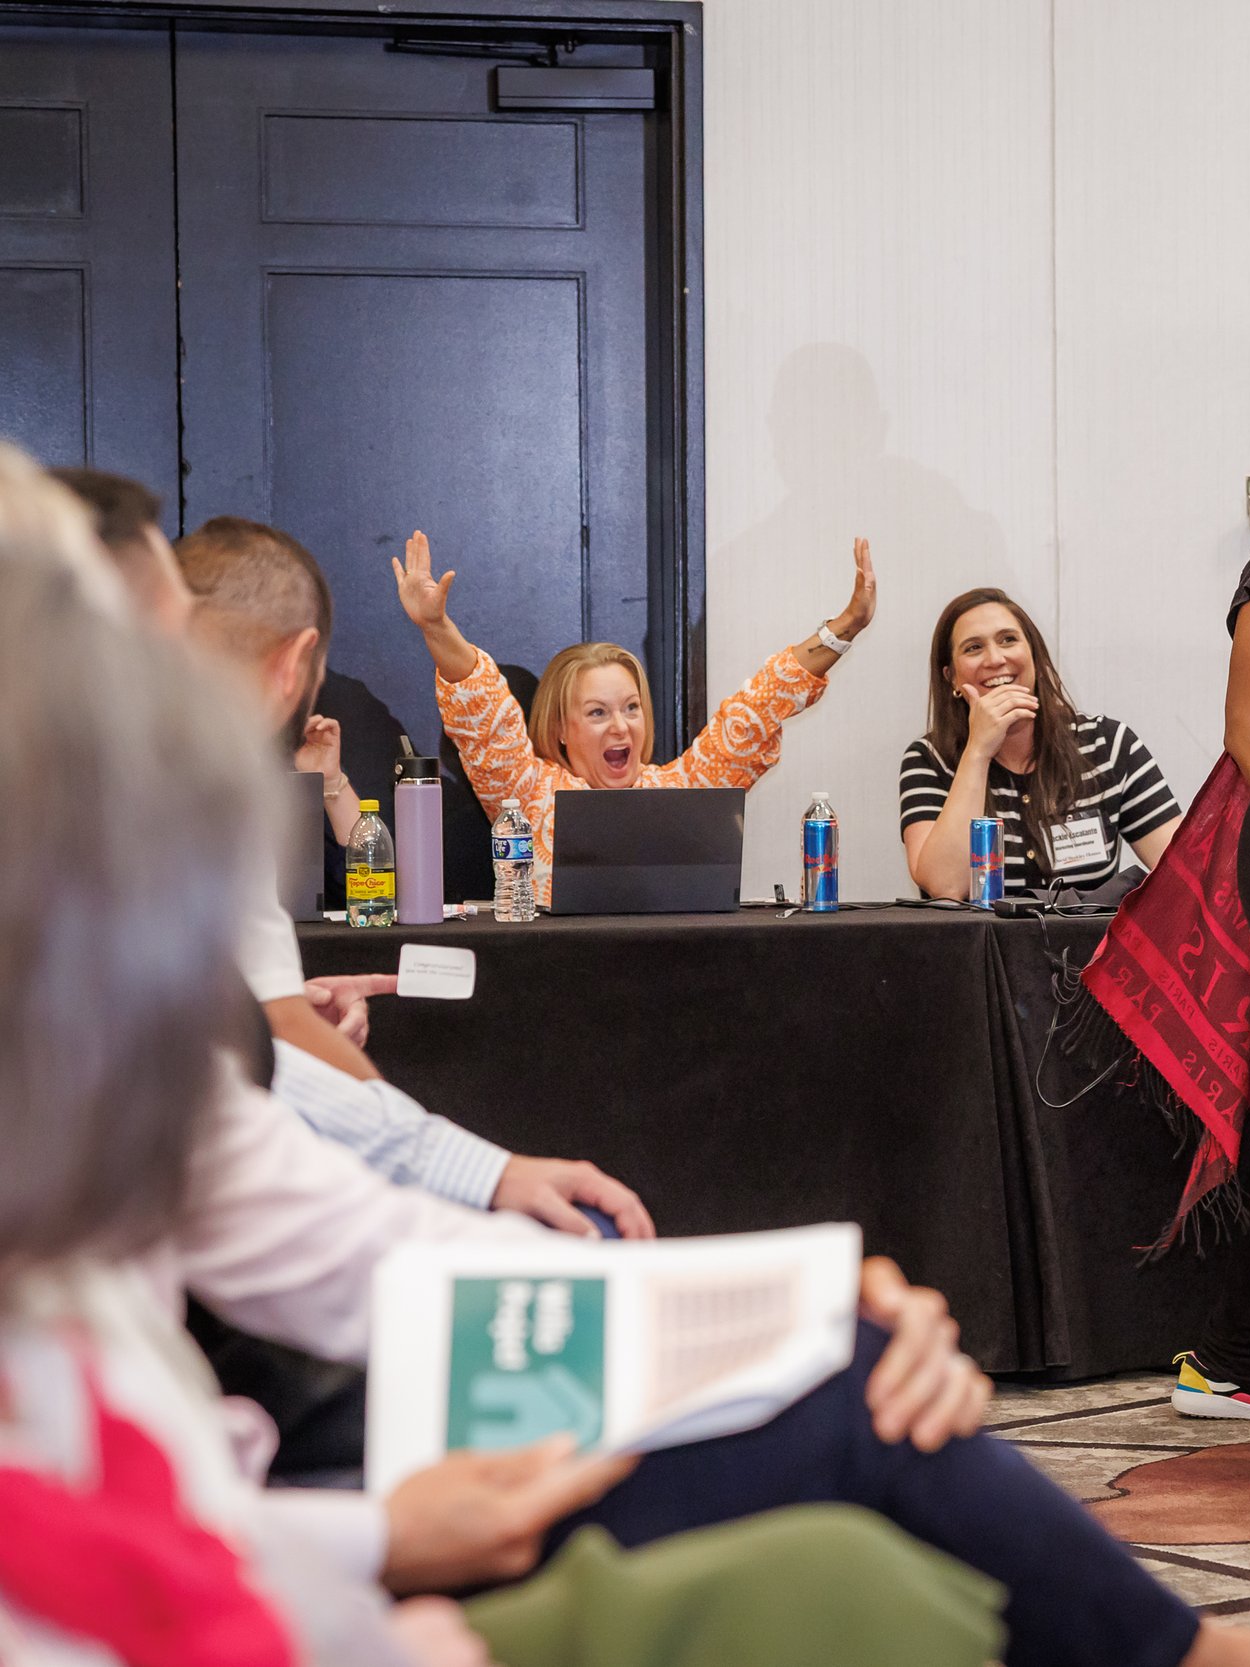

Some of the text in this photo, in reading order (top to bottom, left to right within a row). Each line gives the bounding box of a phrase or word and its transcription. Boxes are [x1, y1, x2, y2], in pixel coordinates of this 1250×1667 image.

[804, 853, 821, 865] Red
[971, 852, 988, 863] Red
[349, 877, 386, 889] Topo Chico
